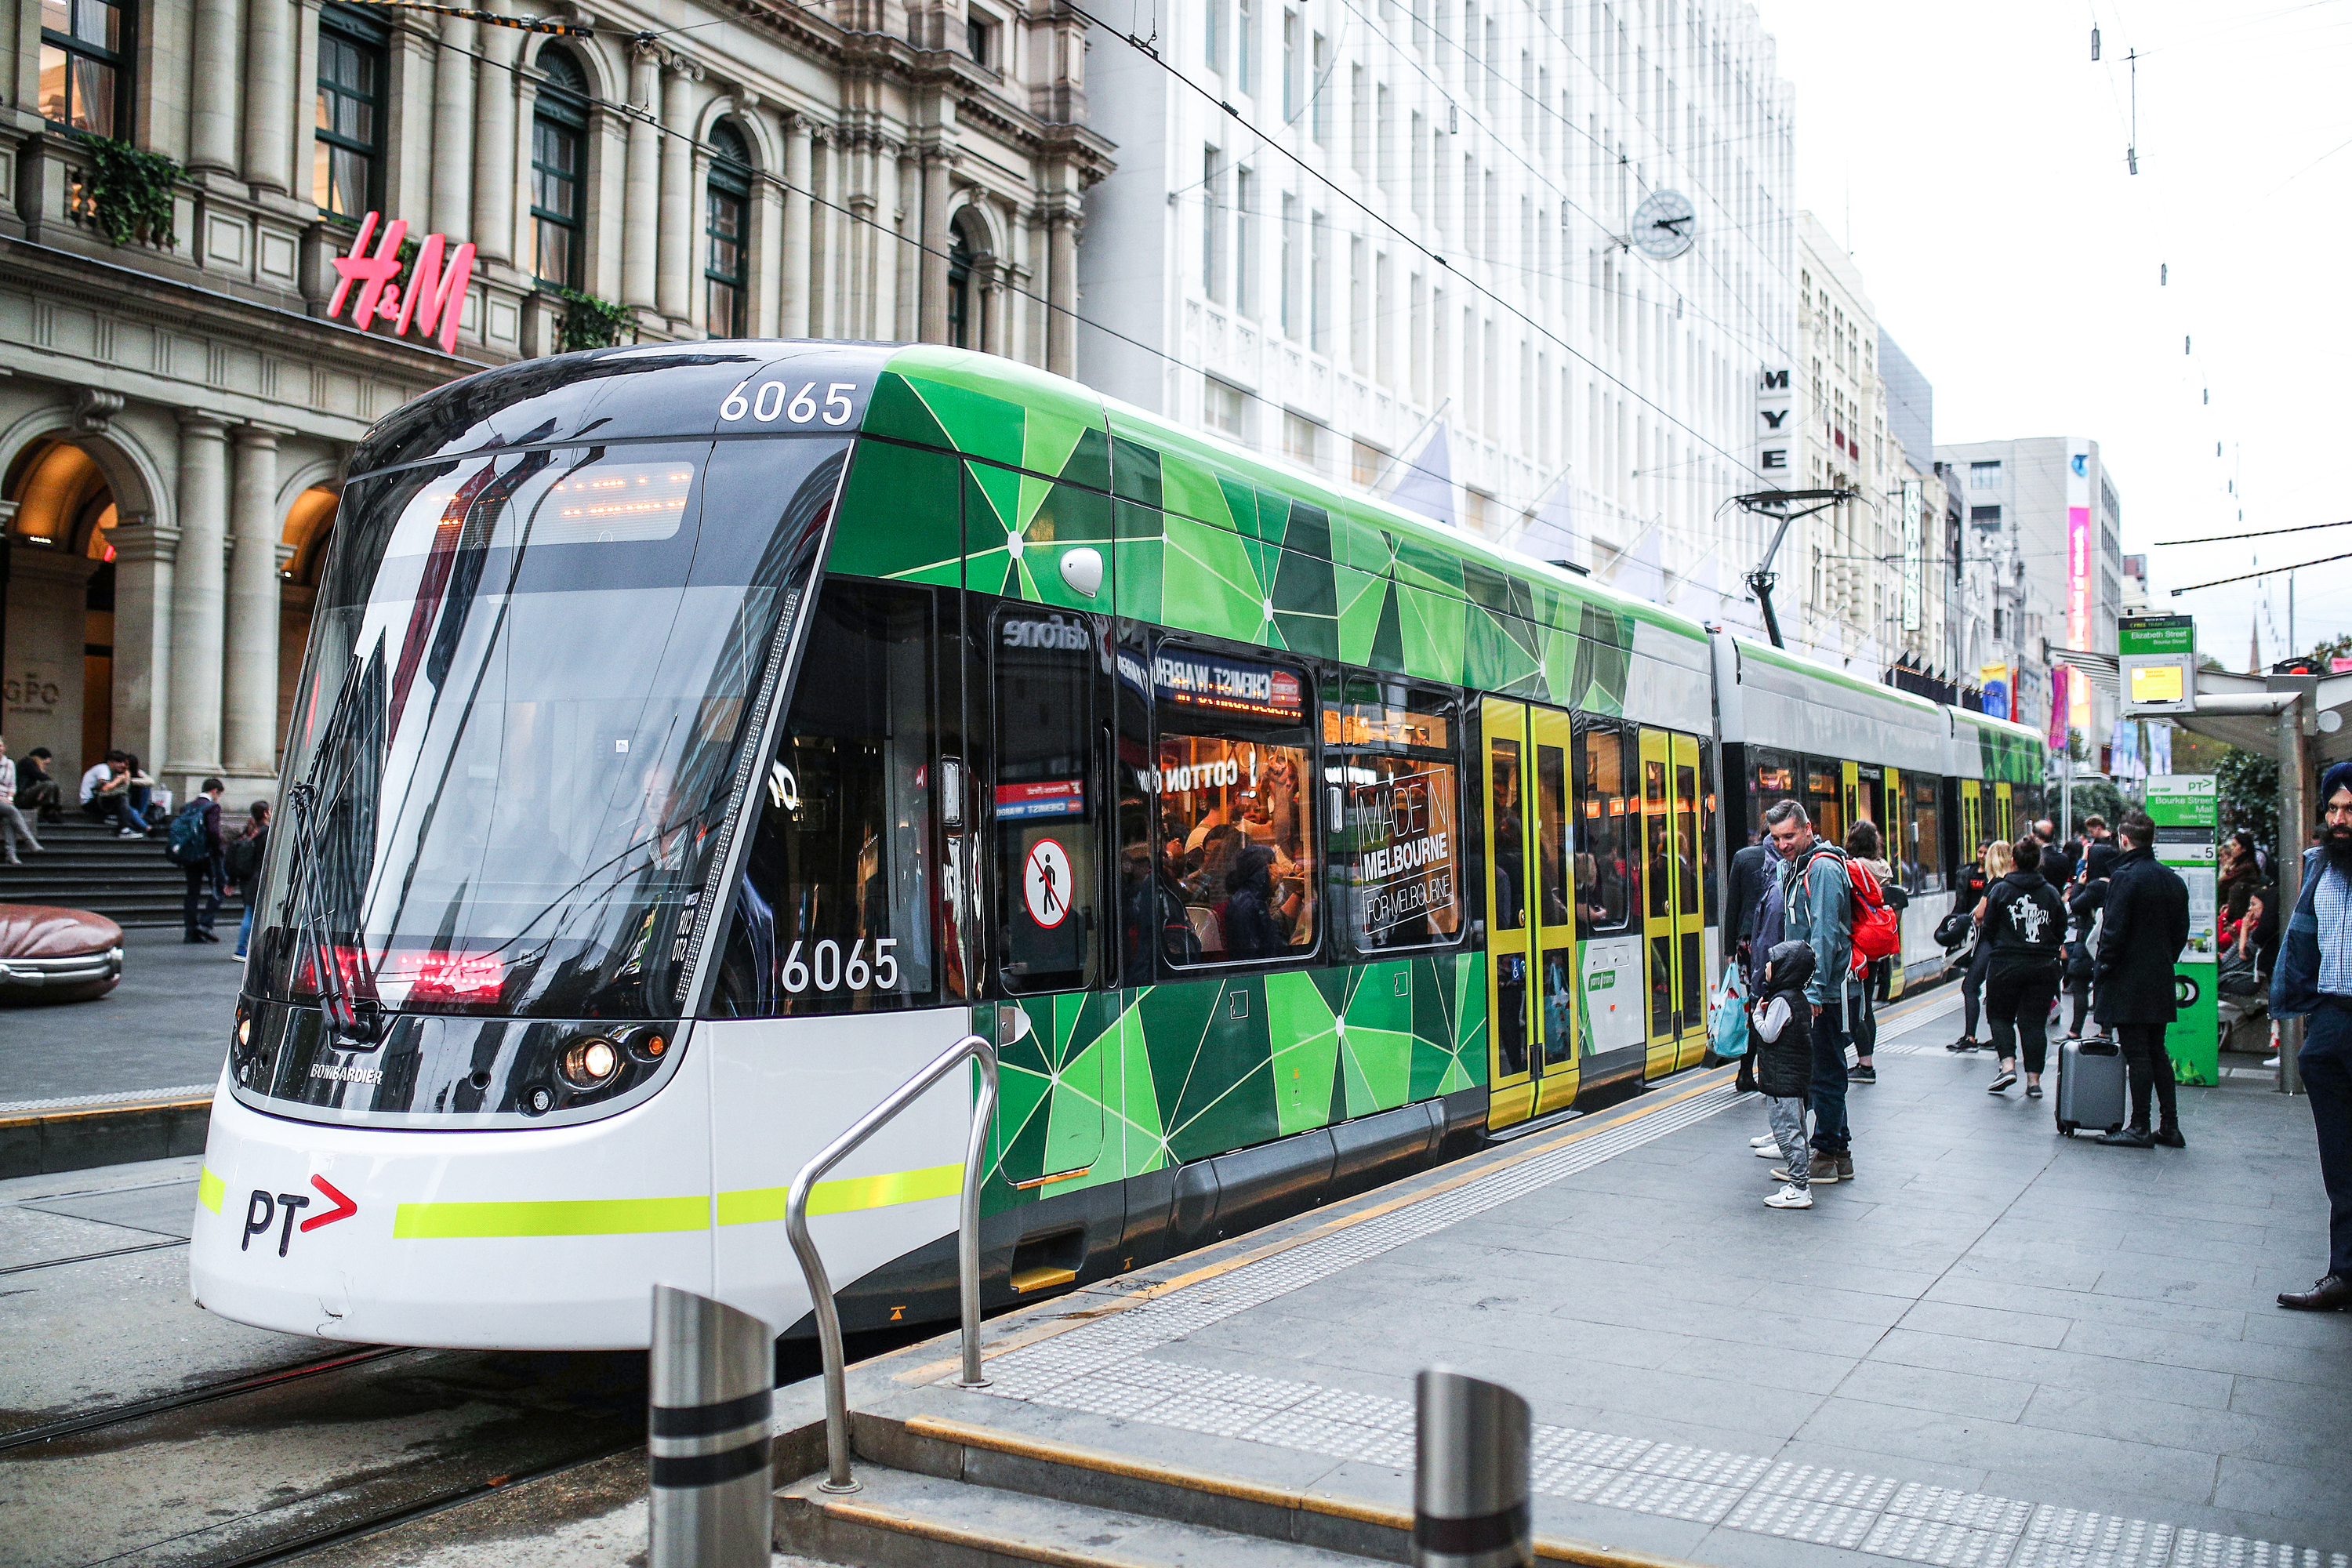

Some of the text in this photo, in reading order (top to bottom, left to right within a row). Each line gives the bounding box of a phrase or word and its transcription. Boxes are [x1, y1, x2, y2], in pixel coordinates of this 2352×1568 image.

[327, 211, 476, 354] H&M
[719, 380, 857, 426] 6065
[1761, 370, 1789, 508] MYE
[1907, 490, 1919, 625] DAVID JONES
[2131, 631, 2164, 640] Elizabeth
[4, 680, 59, 704] GPO
[2187, 796, 2214, 804] Street
[2188, 782, 2203, 792] PT
[1359, 779, 1446, 846] MADE IN
[1363, 832, 1448, 882] MELBOURNE
[2205, 848, 2214, 858] 5
[1367, 874, 1450, 924] FOR MELBOURNE
[782, 938, 898, 993] 6065
[310, 1063, 383, 1085] BOMBARDIER
[241, 1189, 310, 1258] PT
